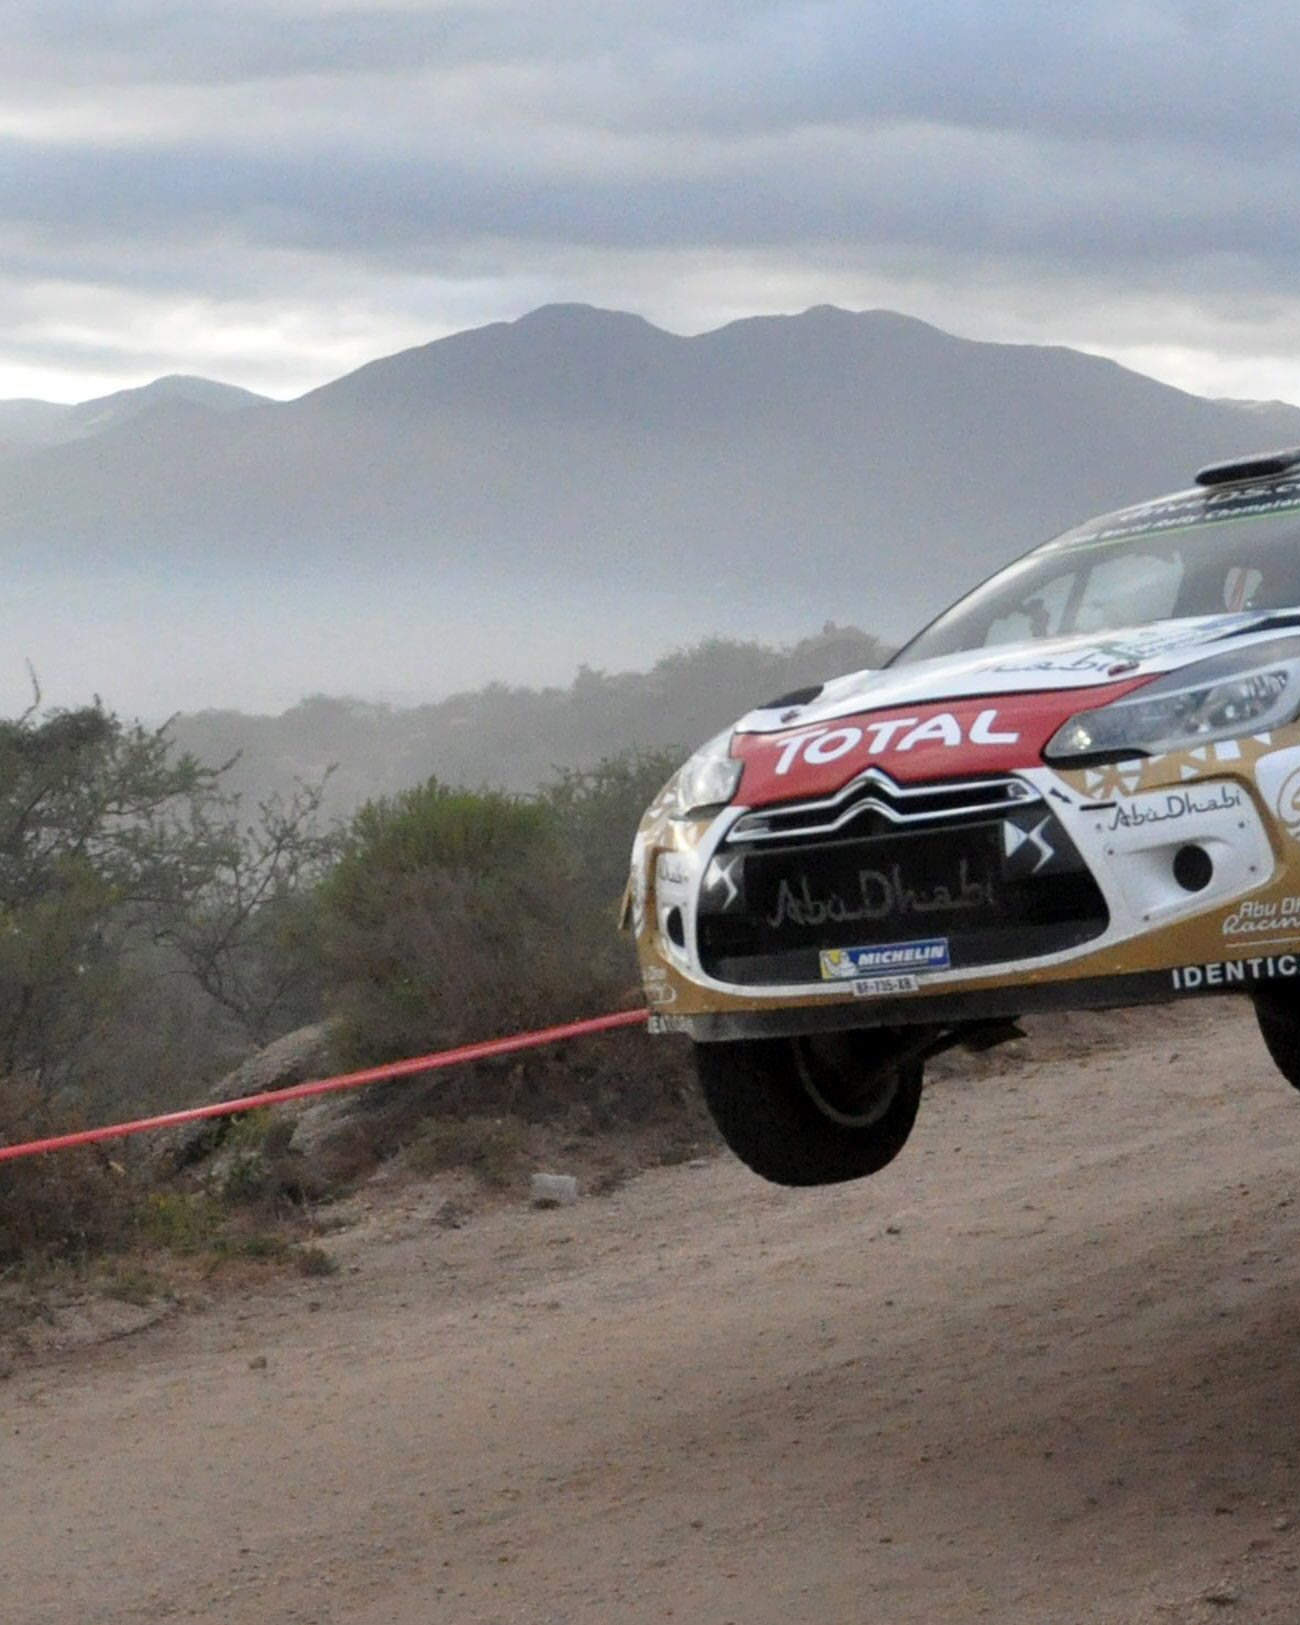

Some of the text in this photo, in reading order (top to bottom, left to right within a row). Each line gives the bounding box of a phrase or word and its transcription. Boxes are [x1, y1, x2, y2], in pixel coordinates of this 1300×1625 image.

[775, 710, 1019, 775] TOTAL
[1238, 899, 1276, 919] Abu
[858, 945, 945, 966] MICHELIN
